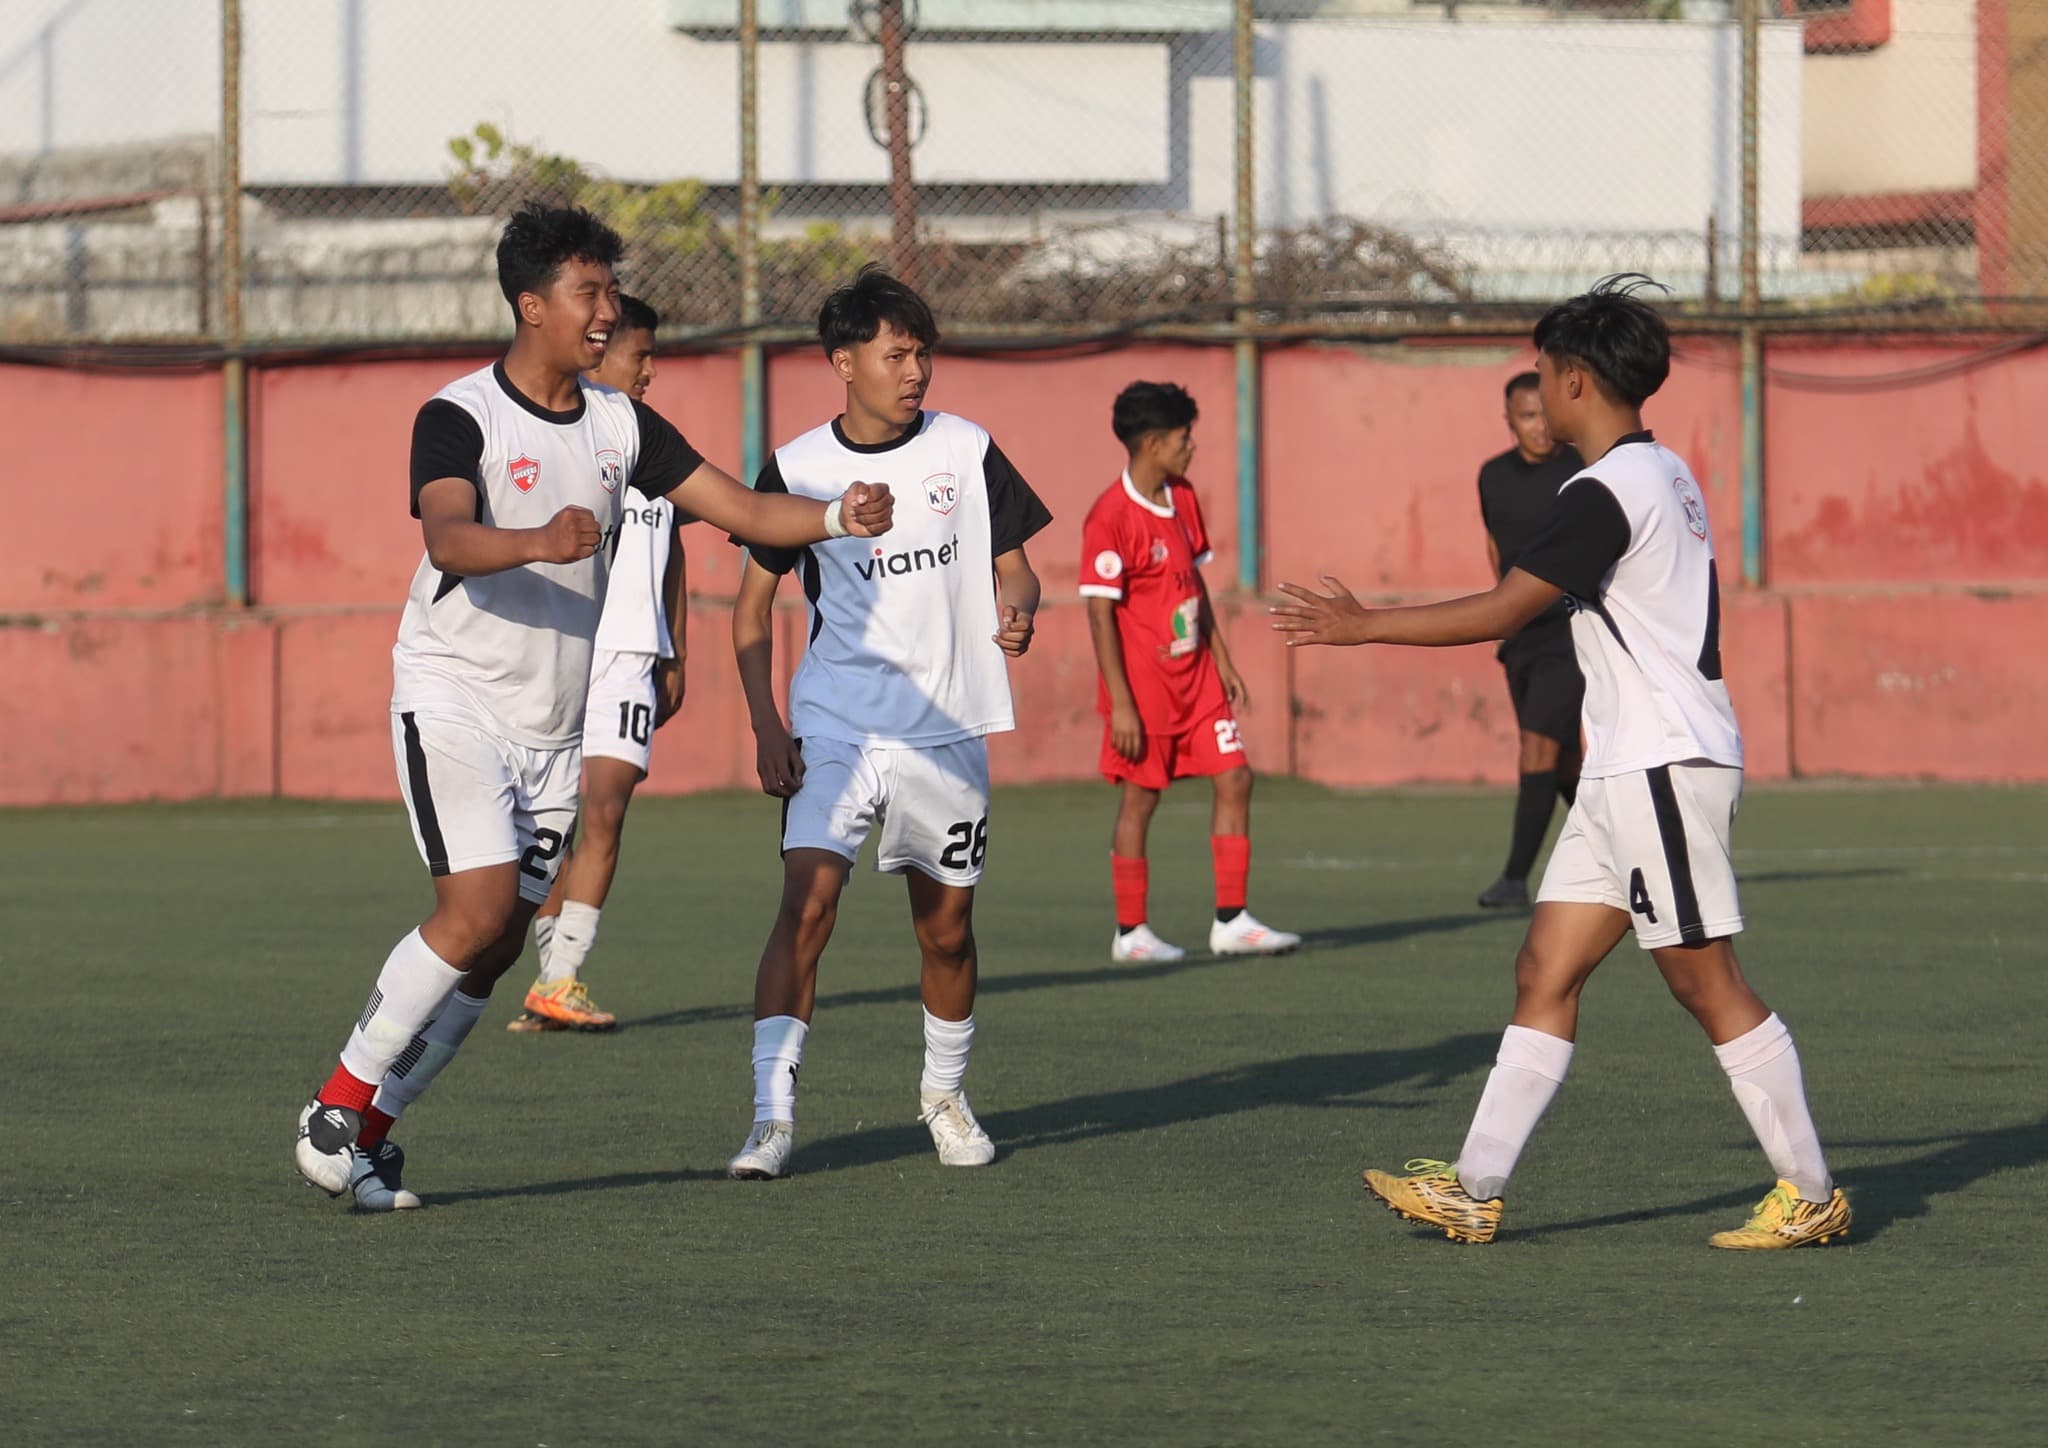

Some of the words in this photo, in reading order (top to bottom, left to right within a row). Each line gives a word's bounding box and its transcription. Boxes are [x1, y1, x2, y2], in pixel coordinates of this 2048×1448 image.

[929, 485, 955, 504] KYC
[853, 533, 958, 581] vianet
[618, 701, 651, 746] 10
[519, 827, 571, 881] 2
[1630, 867, 1658, 923] 4
